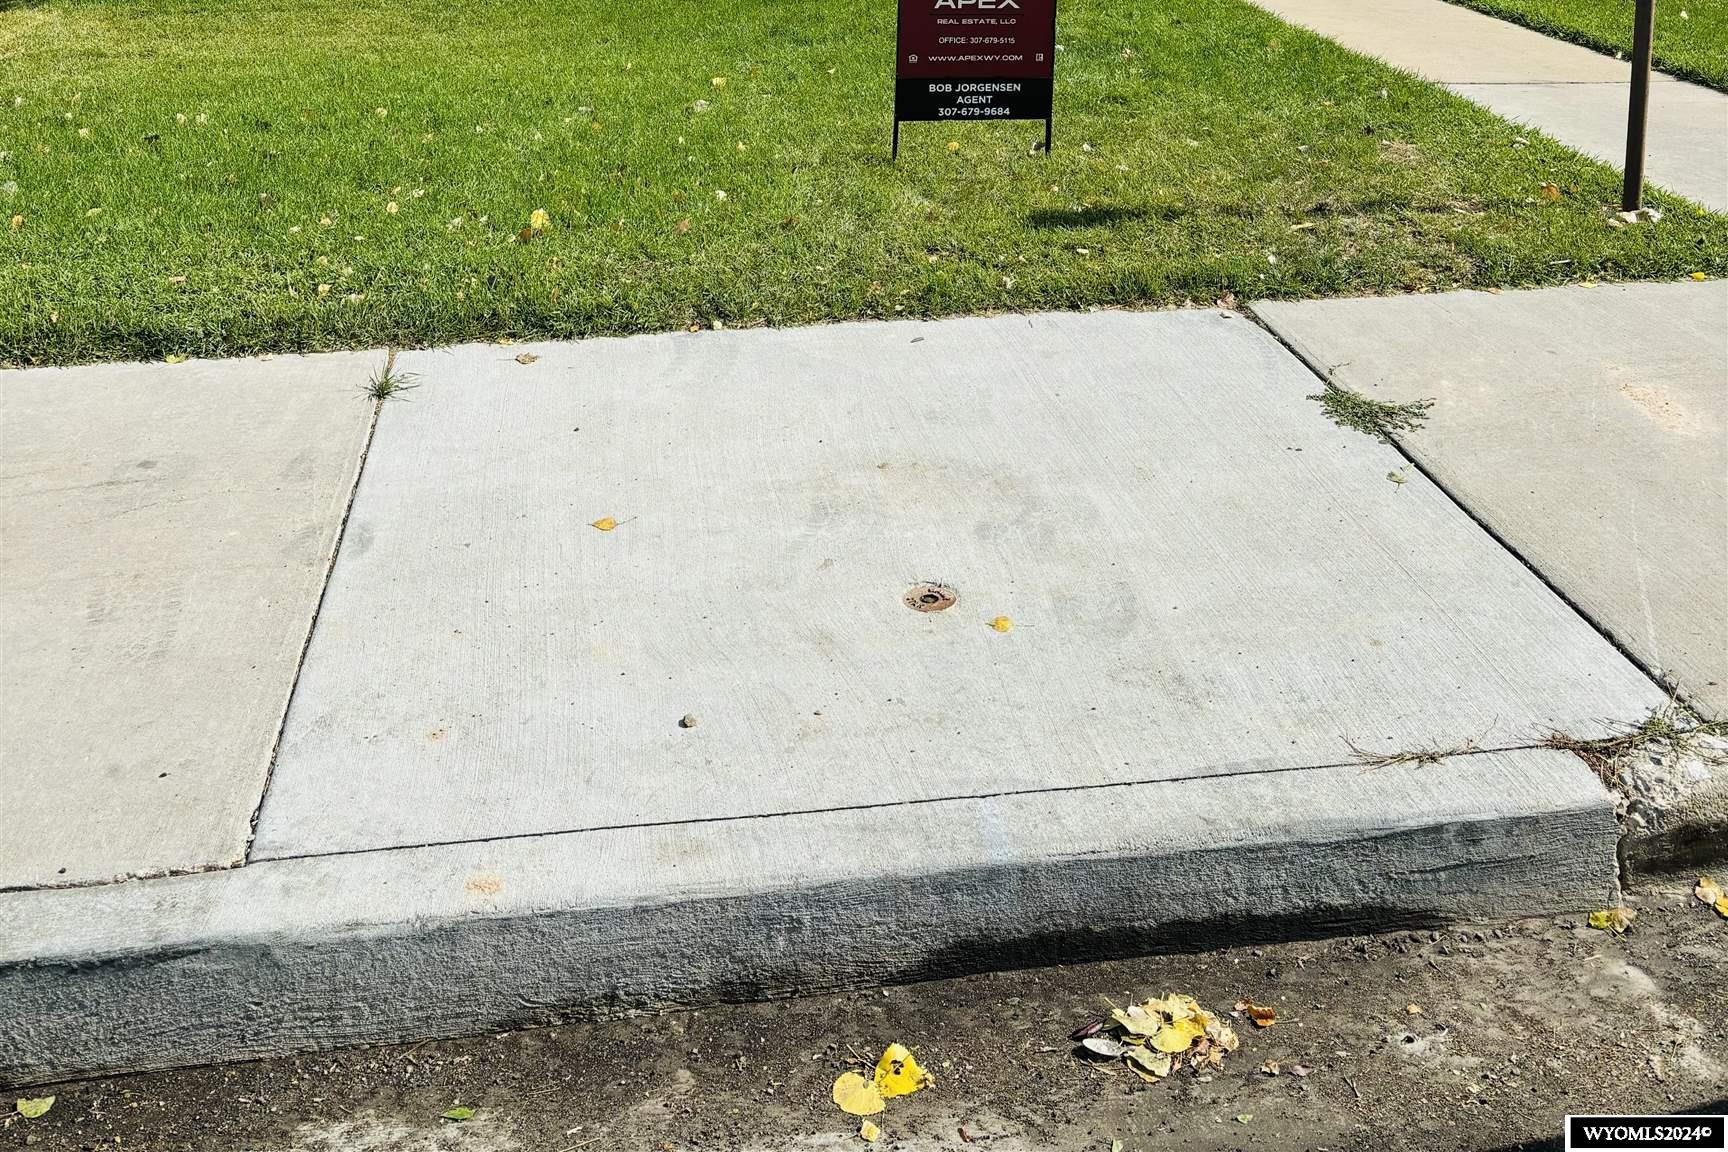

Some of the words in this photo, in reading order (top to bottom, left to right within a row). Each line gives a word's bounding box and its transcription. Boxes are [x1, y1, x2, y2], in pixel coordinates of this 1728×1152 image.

[938, 36, 969, 44] OFFICE:
[928, 54, 1023, 62] WWW.APEXWY.COM
[928, 83, 953, 93] BOB
[955, 83, 1021, 93] JORGENSEN
[956, 95, 993, 104] AGENT
[938, 107, 1011, 117] 307-679-9684
